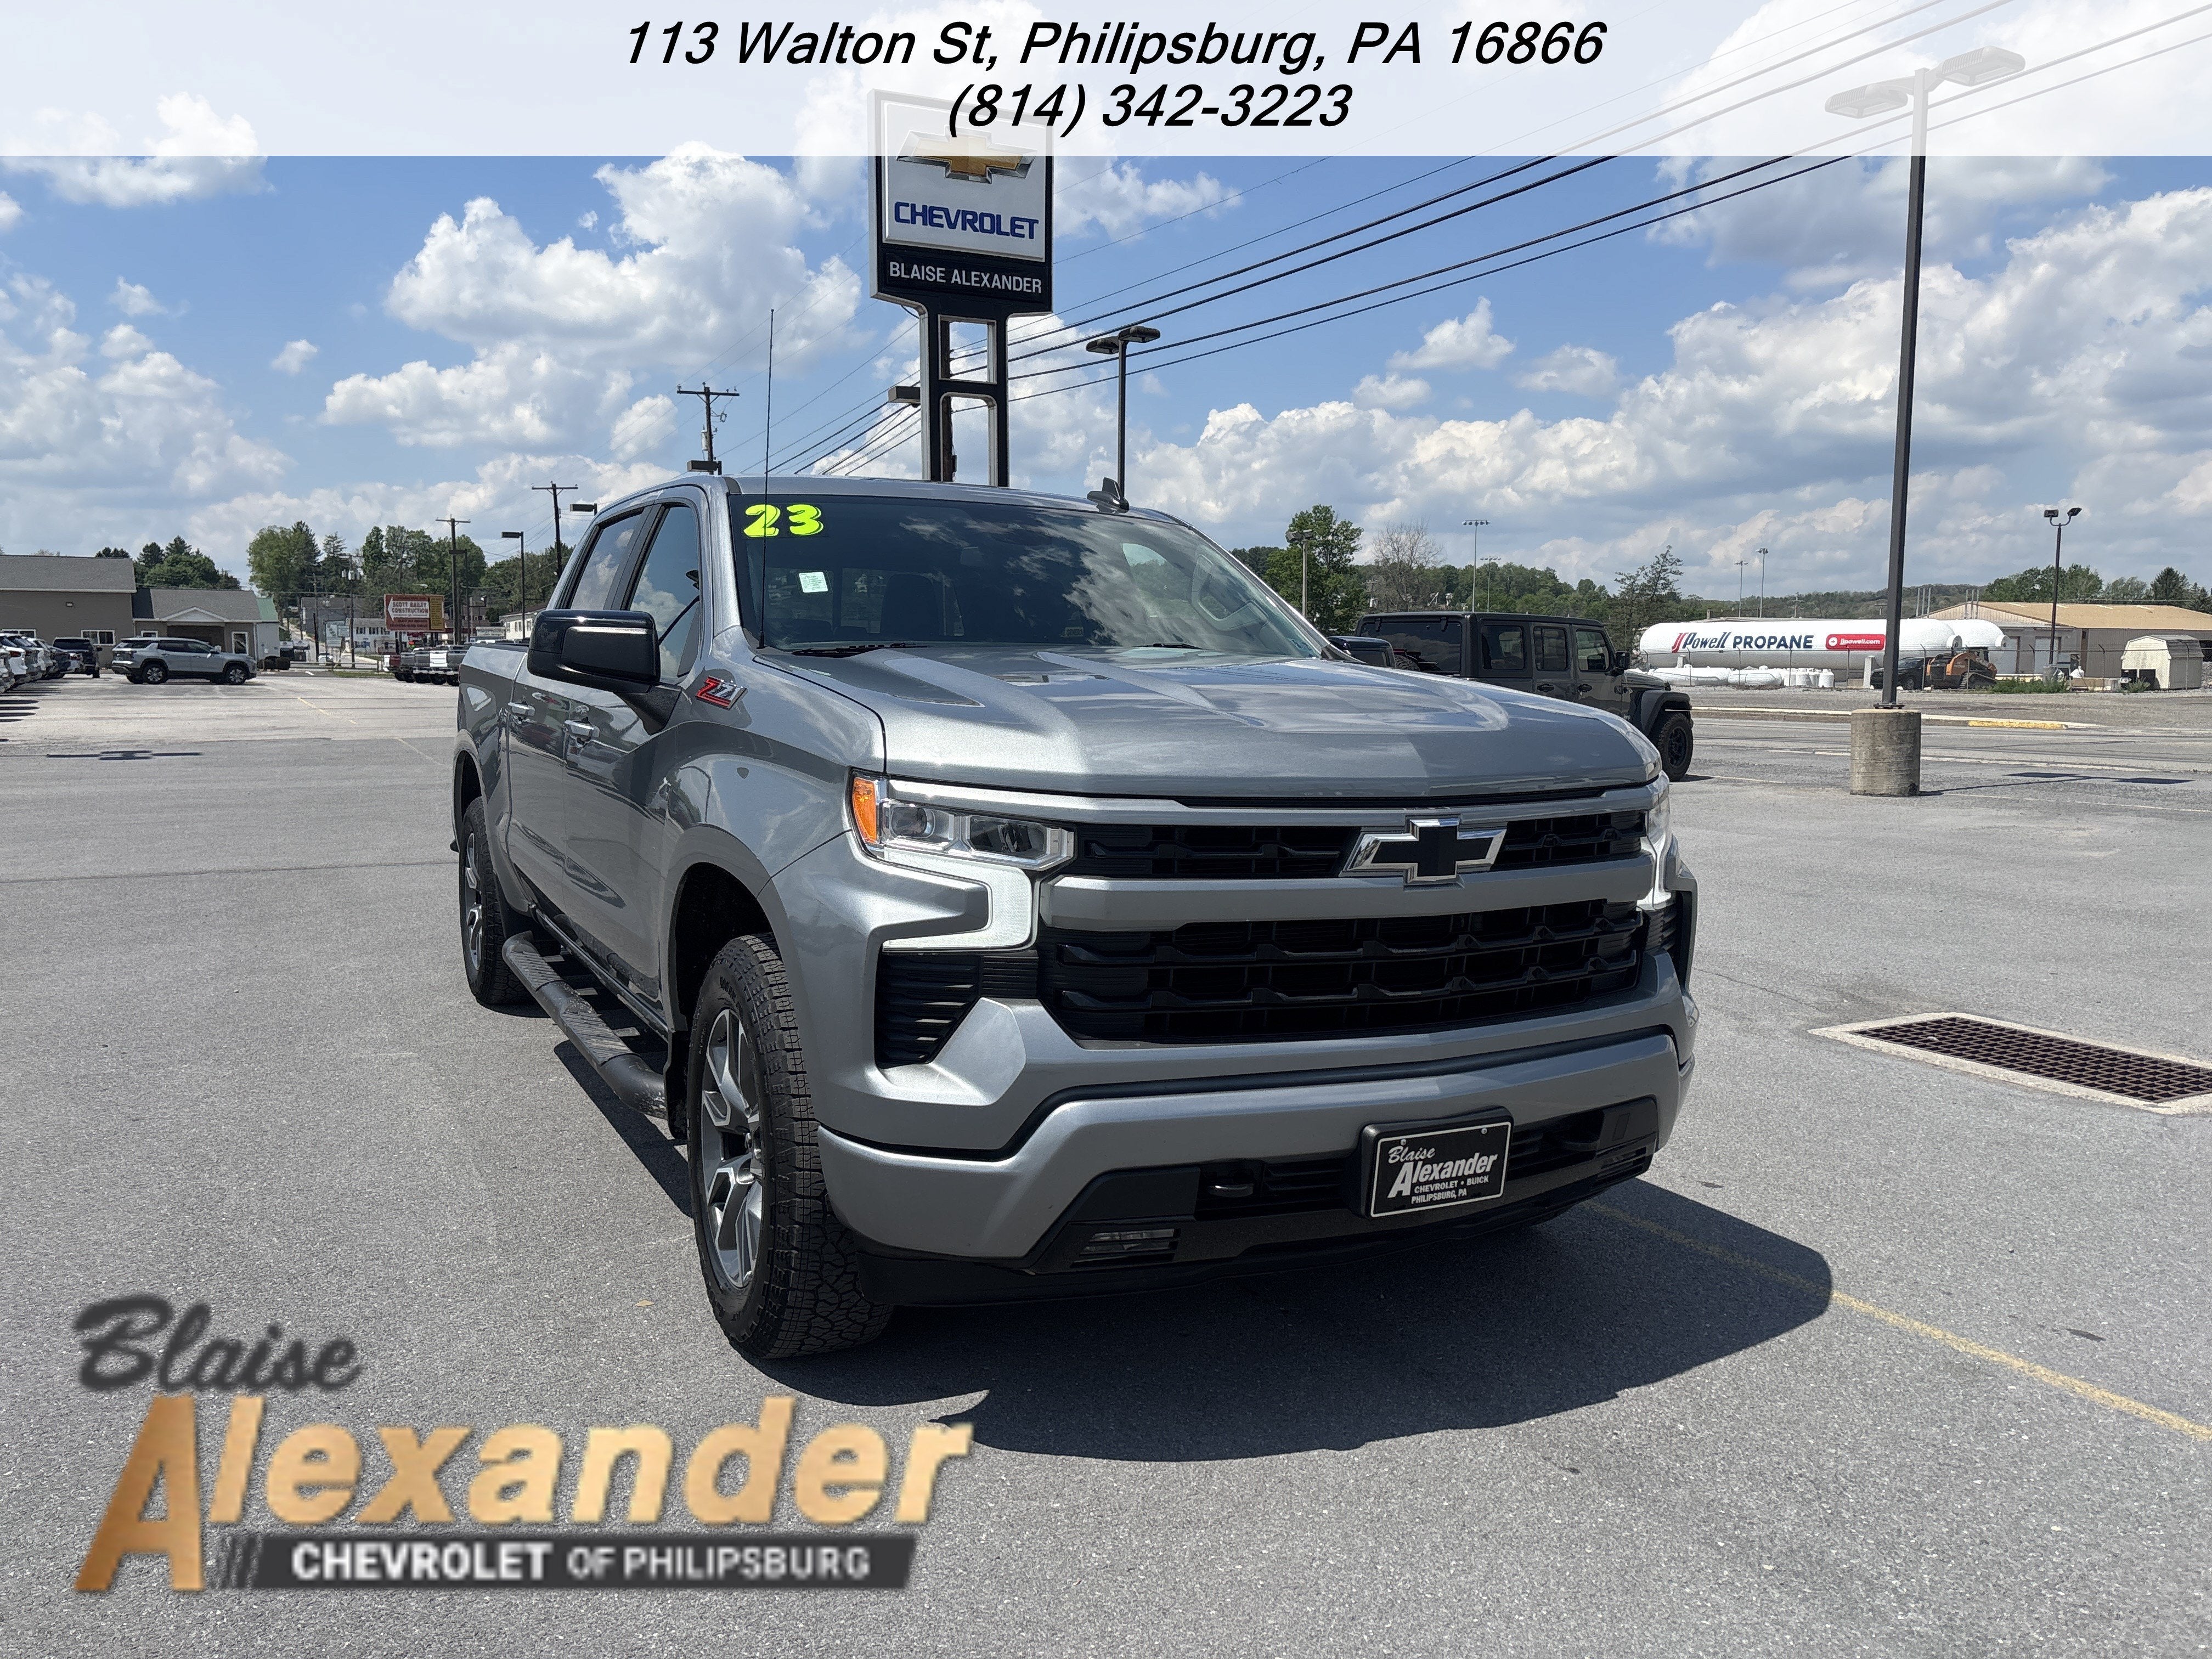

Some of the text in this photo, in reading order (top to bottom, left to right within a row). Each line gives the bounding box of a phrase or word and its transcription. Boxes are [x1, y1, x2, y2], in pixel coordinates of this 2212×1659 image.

[894, 201, 1039, 240] CHEVROLET
[889, 261, 1042, 294] BLAISE ALEXANDER
[743, 503, 824, 537] 23
[1733, 635, 1814, 649] PROPANE
[1388, 1145, 1436, 1164] Blaise
[1387, 1152, 1498, 1199] Alexander
[1414, 1176, 1489, 1194] CHEVROLET BUICK
[1458, 1188, 1468, 1197] PA
